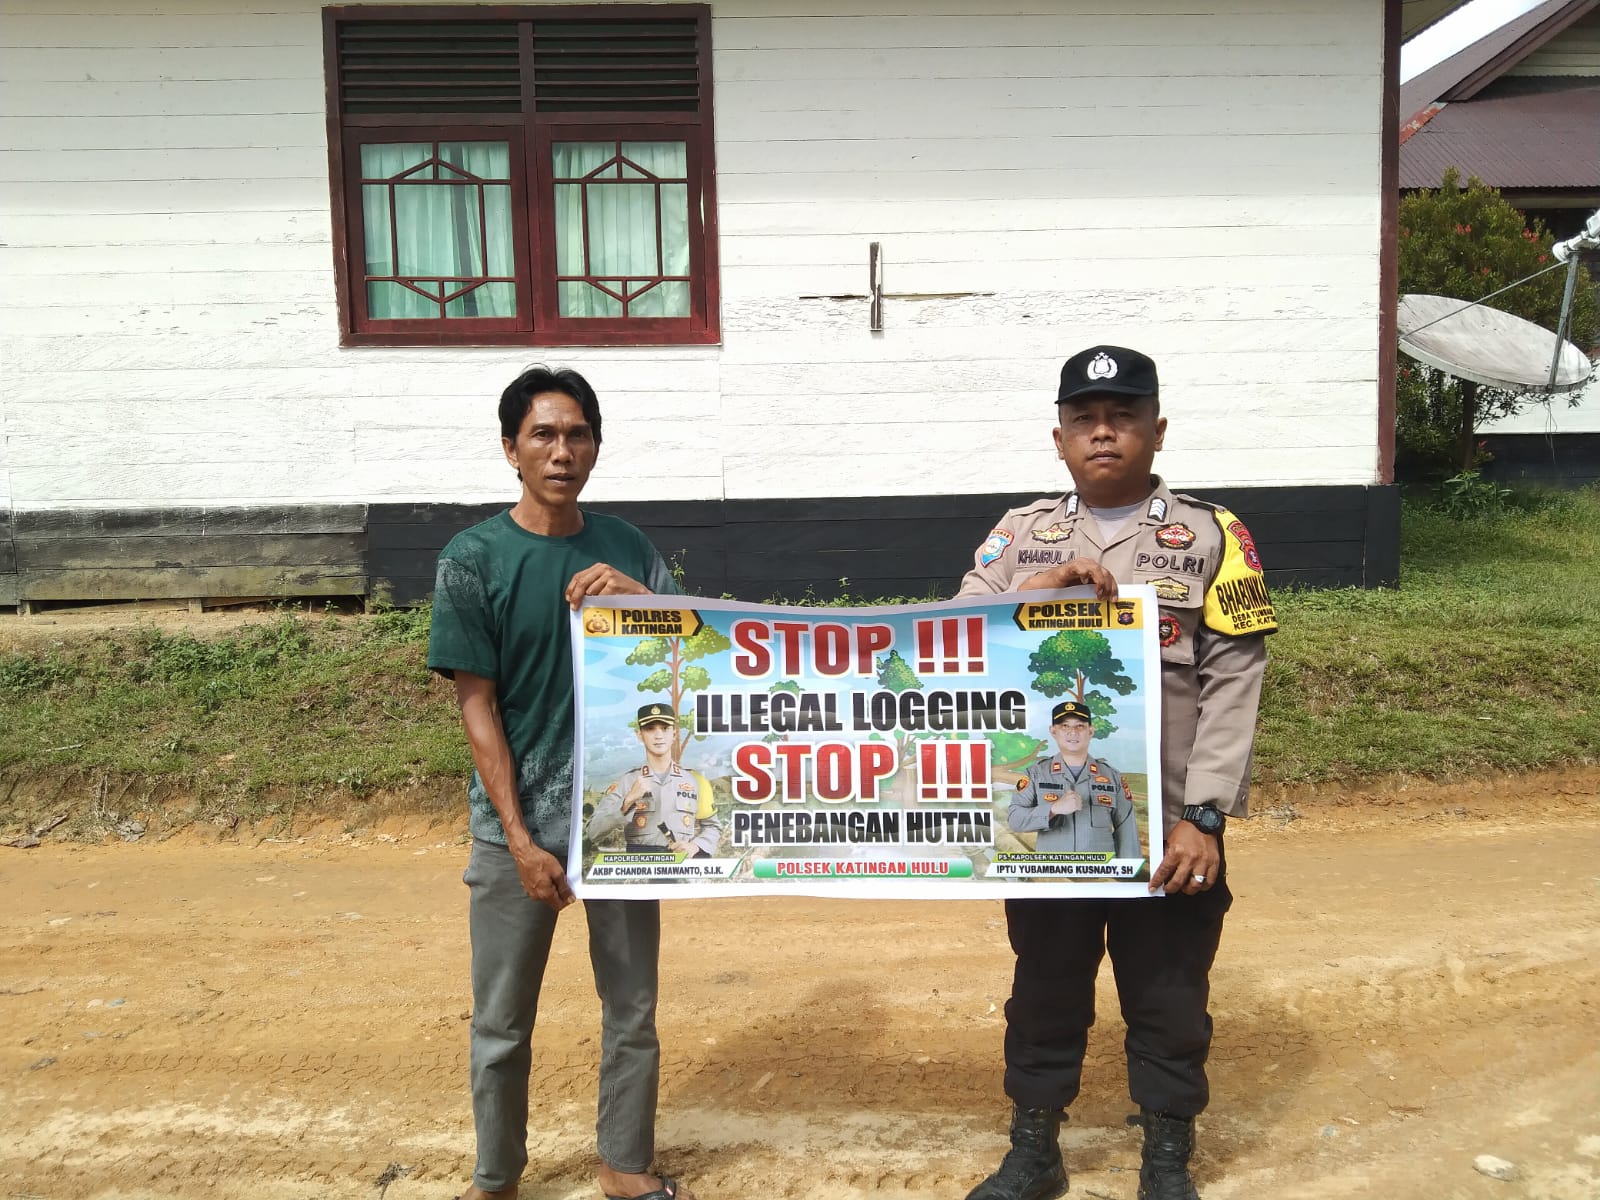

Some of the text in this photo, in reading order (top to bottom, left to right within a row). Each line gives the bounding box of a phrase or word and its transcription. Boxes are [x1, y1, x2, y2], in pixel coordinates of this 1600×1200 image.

[1136, 552, 1205, 574] POLRI
[621, 609, 682, 623] POLRES
[1028, 602, 1102, 618] POLSEK
[621, 623, 682, 635] KATINGAN
[1028, 617, 1103, 629] KATINGAN HULU
[734, 616, 986, 677] STOP !!!
[696, 690, 1026, 733] ILLEGAL LOGGING
[735, 743, 988, 800] STOP !!!
[734, 811, 992, 843] PENEBANGAN HUTAN
[640, 854, 675, 862] KATINGAN
[1011, 853, 1048, 861] KAPOLSEK
[1049, 853, 1085, 861] KATINGAN
[592, 866, 724, 876] AKBP CHANDRA ISMAWANTO, S.I.K.
[777, 861, 949, 875] POLSEK KATINGAN HULU
[996, 865, 1133, 876] IPTU YUBAMBANG KUSNADY, SH
